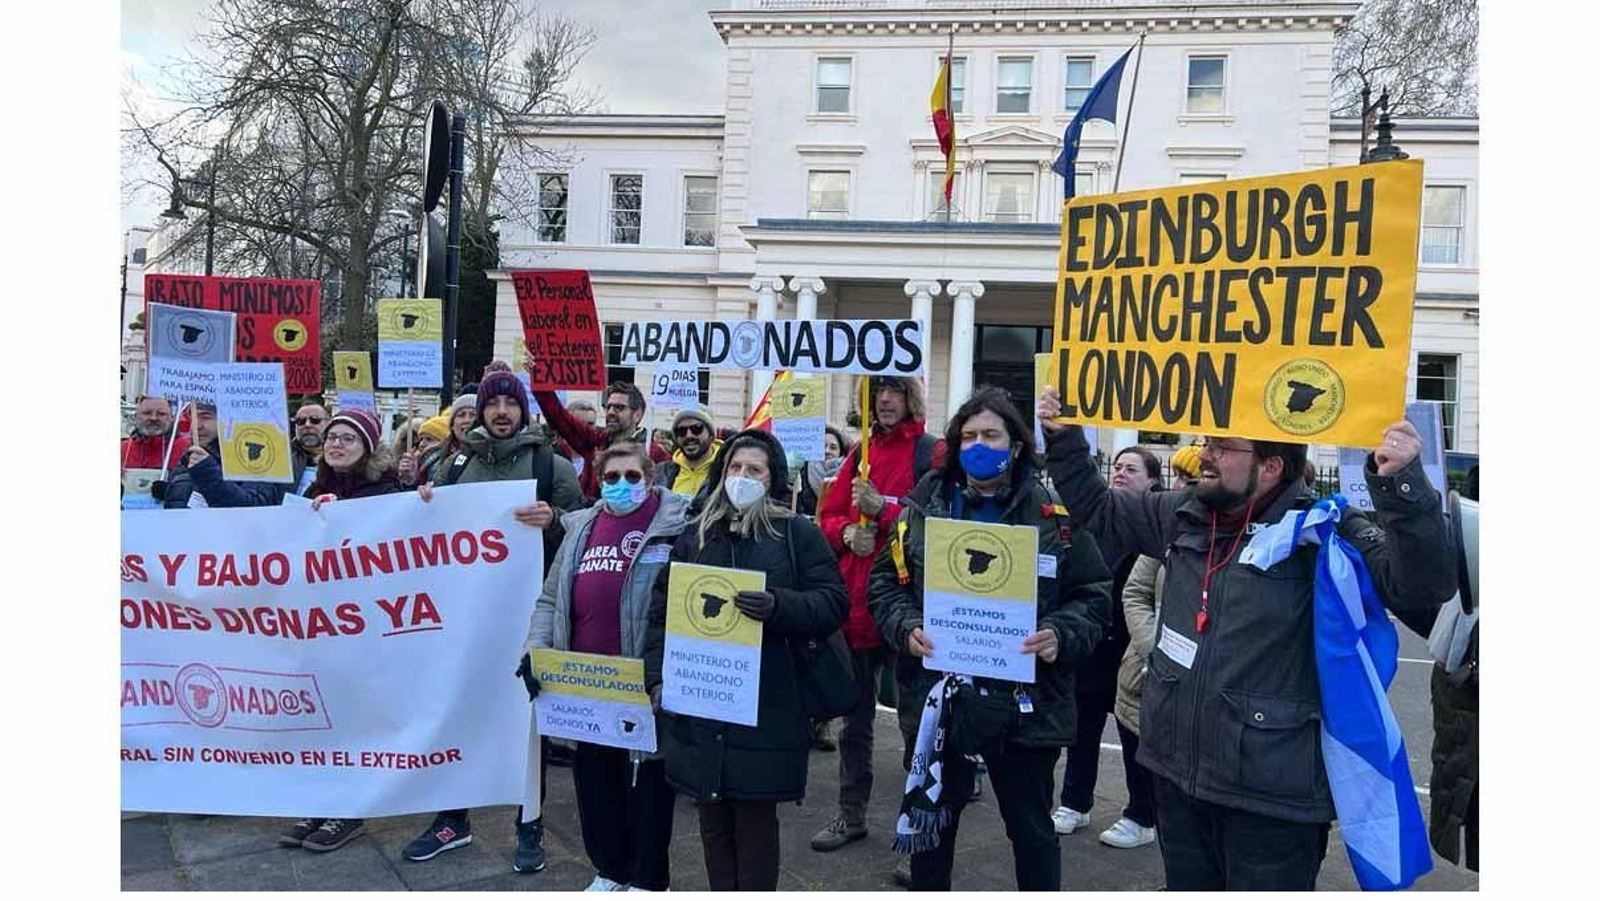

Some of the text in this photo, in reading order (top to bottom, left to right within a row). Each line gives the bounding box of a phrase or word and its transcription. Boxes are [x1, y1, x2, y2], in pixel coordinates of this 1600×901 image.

[1066, 178, 1375, 272] EDINBURGH
[540, 275, 593, 299] Personal
[1060, 265, 1385, 349] MANCHESTER
[575, 315, 592, 330] en
[546, 333, 598, 357] Exterior
[161, 367, 215, 381] TRABAJAMO
[220, 372, 276, 382] MINISTERIO DE
[532, 359, 600, 385] EXISTE
[672, 369, 696, 382] DIAS
[160, 380, 182, 390] PARA
[225, 387, 274, 395] ABANDONO
[1059, 348, 1237, 429] LONDON
[159, 554, 187, 586] Y
[198, 553, 291, 586] BAJO
[305, 529, 509, 584] MÍNIMOS
[215, 602, 366, 640] DIGNAS
[376, 593, 442, 629] YA
[952, 607, 1006, 620] ¡ESTAMOS
[930, 618, 1029, 637] DESCONSULADOS!
[956, 635, 1002, 649] SALARIOS
[670, 650, 751, 671] MINISTERIO DE
[949, 651, 1007, 667] DIGNOS YA
[563, 662, 619, 676] ¡ESTAMOS
[674, 668, 743, 688] ABANDONO
[541, 671, 644, 693] DESCONSULADOS!
[681, 685, 735, 703] EXTERIOR
[551, 703, 595, 717] SALARIOS
[546, 715, 602, 733] DIGNOS YA
[164, 747, 195, 762] SIN
[201, 748, 294, 766] CONVENIO
[301, 751, 326, 766] EN
[332, 751, 355, 767] EL
[361, 748, 462, 770] EXTERIOR
